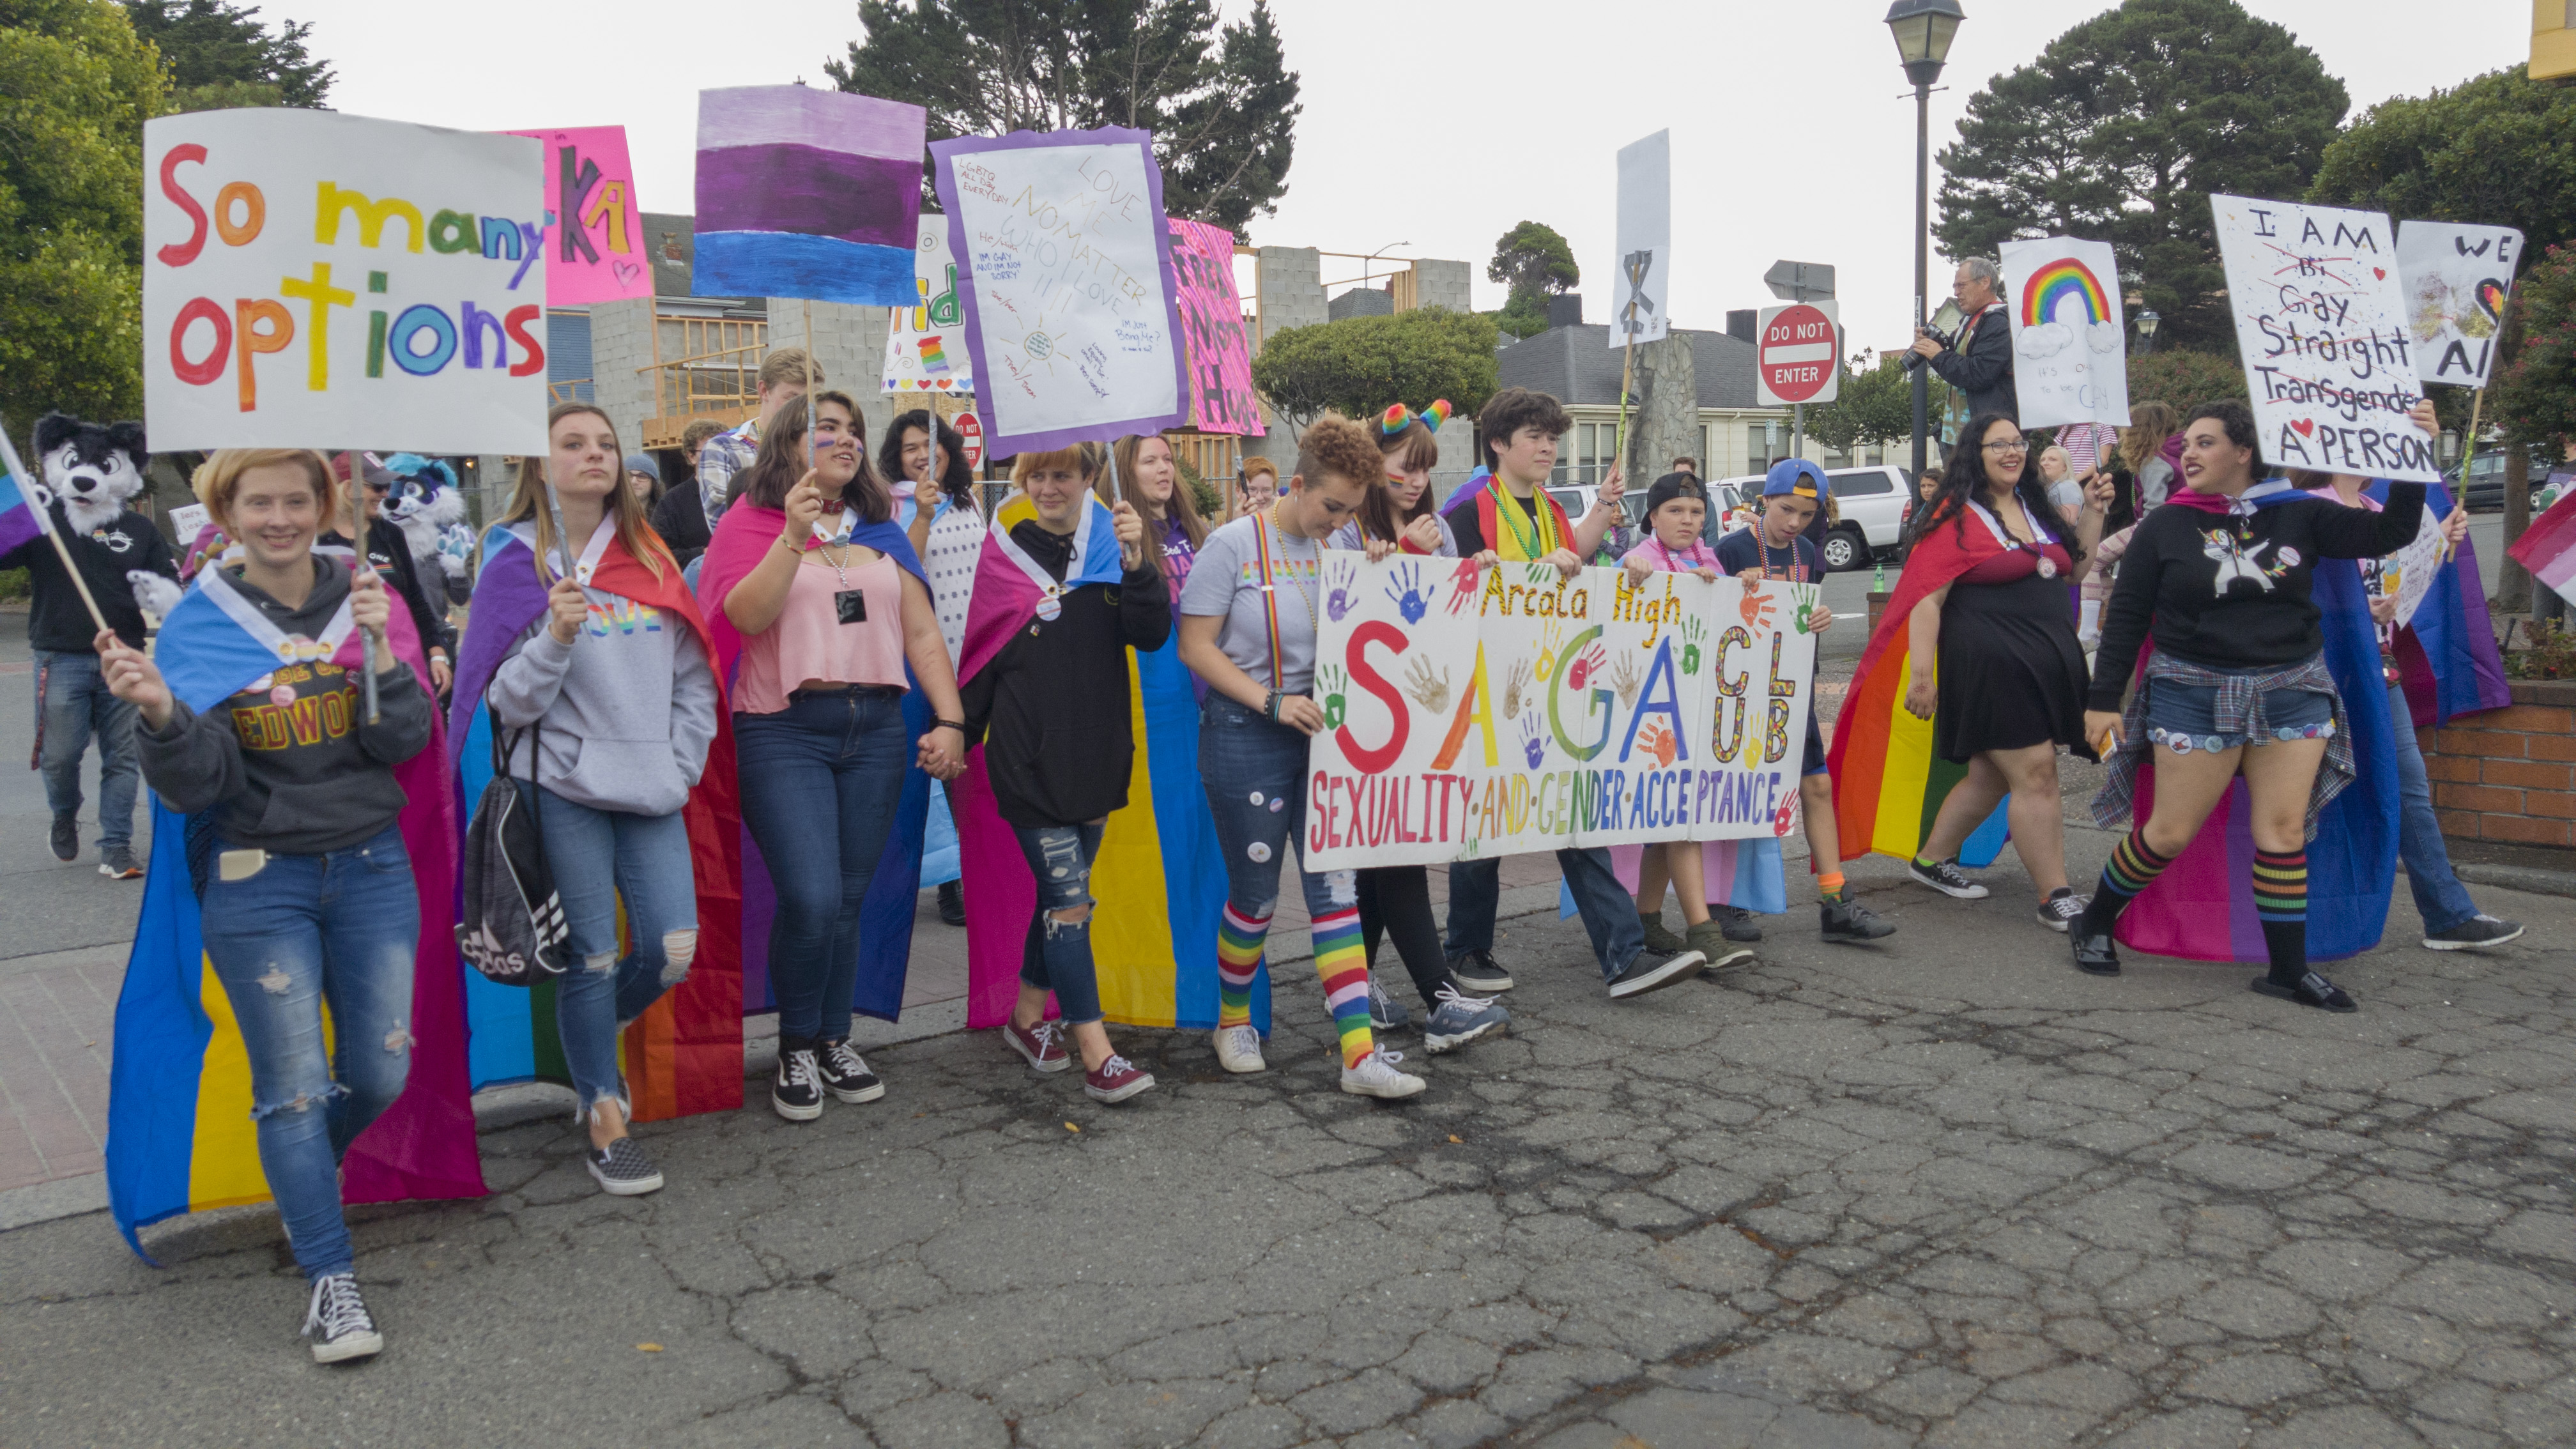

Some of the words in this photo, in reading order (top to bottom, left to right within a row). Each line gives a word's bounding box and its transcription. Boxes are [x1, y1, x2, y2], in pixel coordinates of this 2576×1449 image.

[959, 158, 996, 181] LGBTQ
[960, 171, 976, 182] ALL
[1078, 156, 1142, 222] LOVE
[157, 142, 266, 267] So
[314, 180, 544, 290] many
[544, 146, 631, 266] KA
[1063, 192, 1116, 238] ME
[2248, 208, 2276, 237] I
[2301, 217, 2378, 254] AM
[2455, 235, 2512, 263] WE
[976, 263, 993, 272] AND
[993, 252, 1011, 262] GAY
[1001, 215, 1057, 268] WHO
[1073, 270, 1123, 316] LOVE
[2299, 257, 2326, 277] Bi
[893, 262, 964, 335] rid
[2279, 284, 2349, 326] Gay
[169, 262, 545, 413] options
[1771, 325, 1790, 342] DO
[1797, 322, 1825, 339] NOT
[2258, 314, 2409, 379] Straight
[1775, 366, 1818, 384] ENTER
[955, 424, 963, 434] DO
[966, 424, 977, 434] NOT
[2280, 423, 2312, 465] A
[2316, 424, 2439, 471] PERSON
[965, 450, 976, 459] TER
[578, 599, 661, 638] OVE
[1480, 565, 1588, 619] Arcata
[1613, 571, 1681, 649] High
[231, 686, 359, 751] EDWO
[1335, 620, 1690, 775] SAGA
